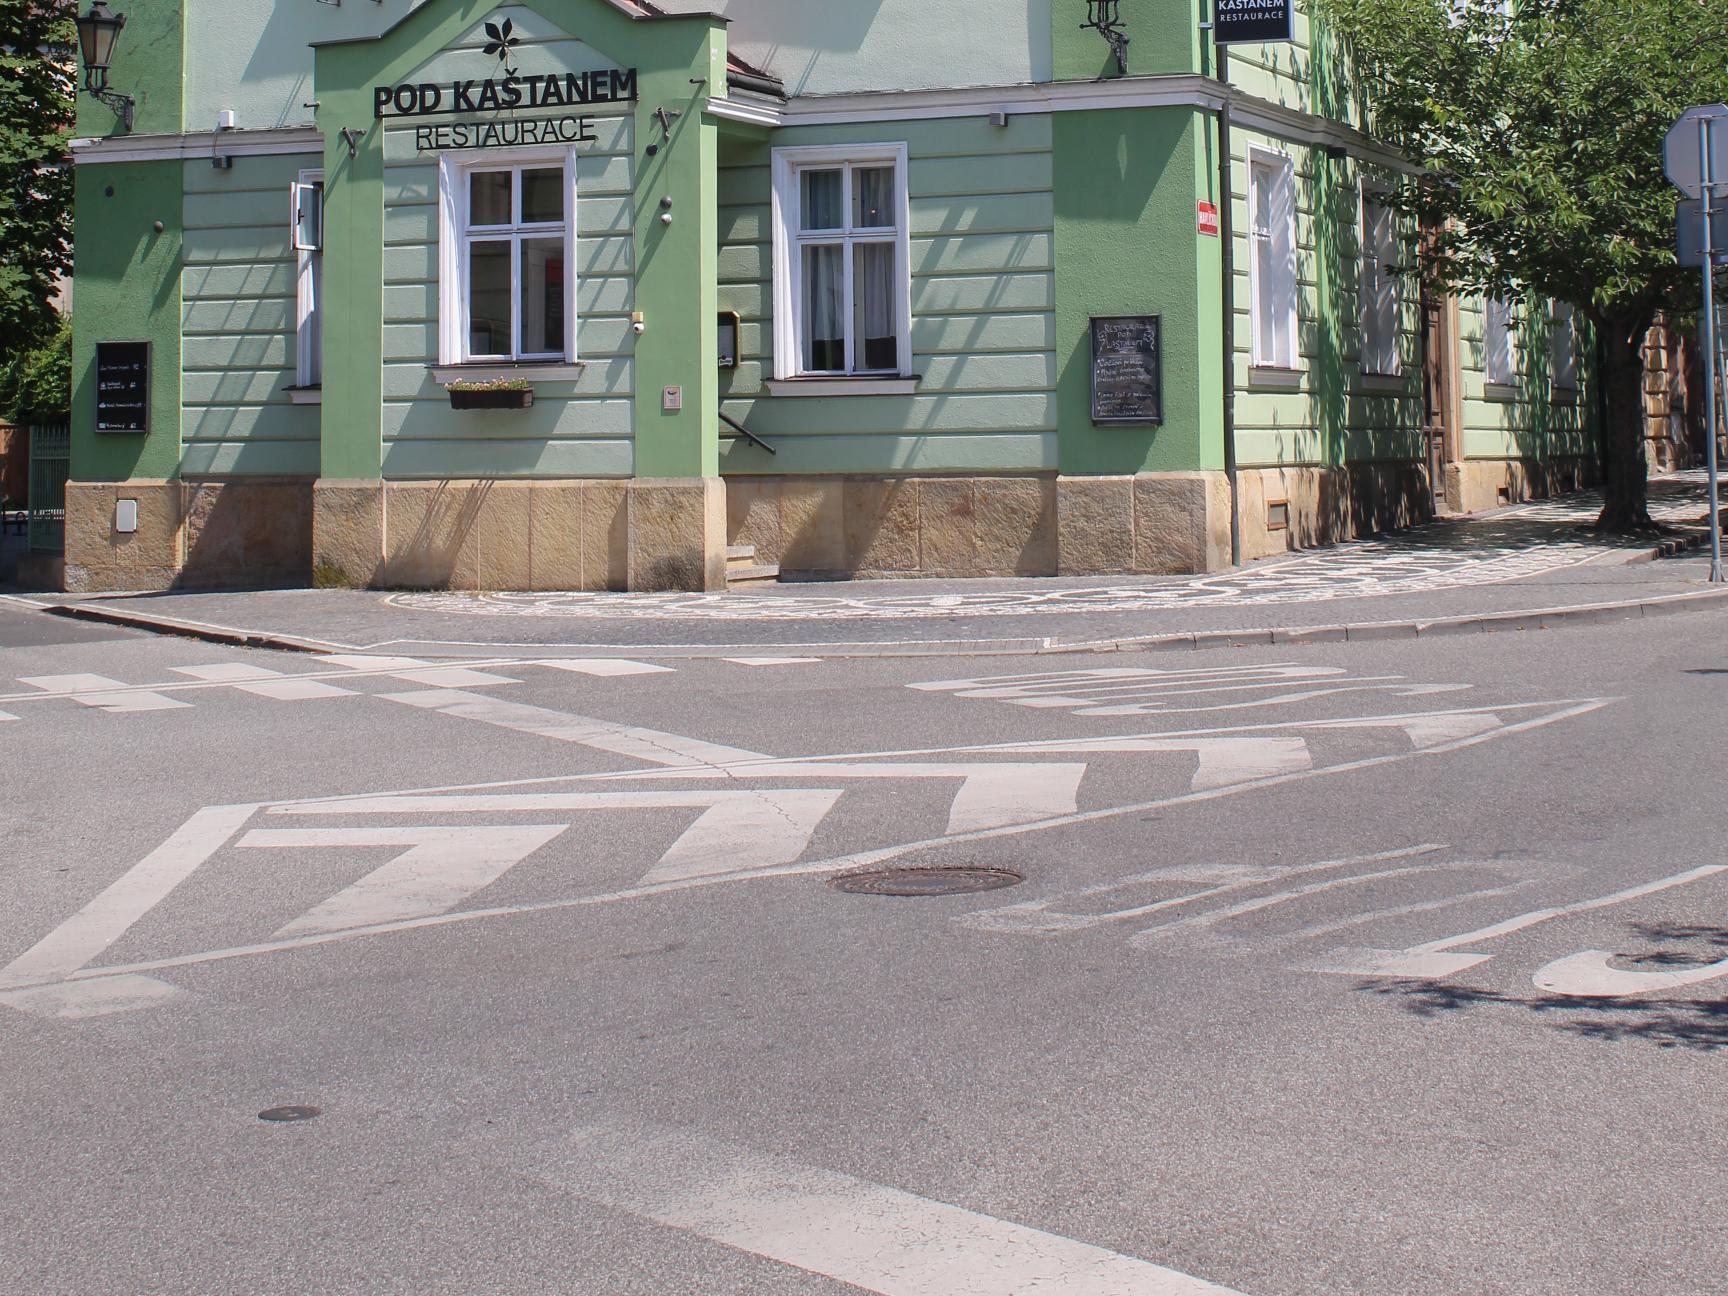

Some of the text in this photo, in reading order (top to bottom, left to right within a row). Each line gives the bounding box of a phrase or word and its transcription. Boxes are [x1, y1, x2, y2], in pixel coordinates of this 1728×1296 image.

[1220, 10, 1284, 22] RESTAURACE
[374, 67, 639, 119] POD KAŠTANEM
[416, 115, 595, 150] RESTAURACE
[904, 662, 1476, 716] STOP
